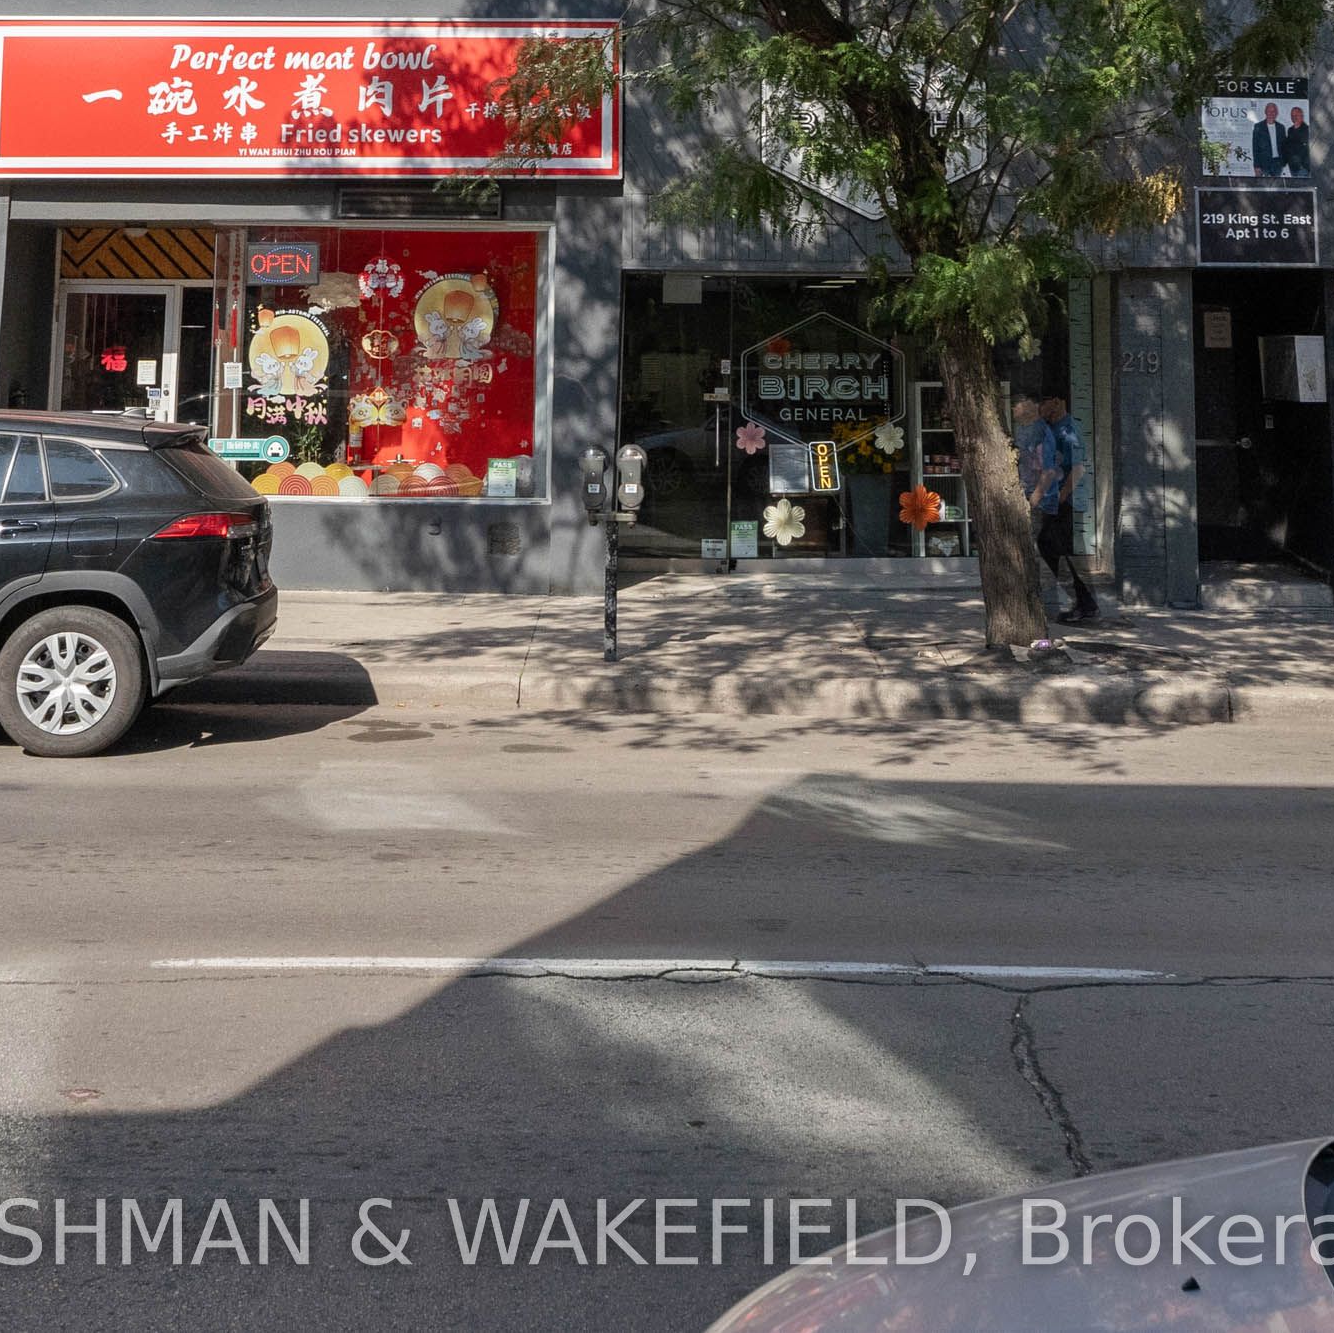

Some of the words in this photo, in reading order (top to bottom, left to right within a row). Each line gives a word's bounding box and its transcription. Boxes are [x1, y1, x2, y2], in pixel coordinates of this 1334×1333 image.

[169, 43, 276, 75] Perfect
[283, 45, 355, 70] meat
[362, 41, 437, 70] bowl
[81, 73, 453, 120] 一碗水煮肉片
[1254, 81, 1295, 94] SALE
[1210, 106, 1248, 119] OPUS
[161, 122, 259, 145] 手工炸串
[280, 123, 342, 144] Fried
[348, 123, 442, 144] skewers
[248, 147, 270, 156] WAN
[271, 147, 293, 156] SHUI
[294, 148, 311, 156] ZHU
[313, 147, 333, 156] ROU
[335, 147, 356, 156] PIAN
[1202, 214, 1224, 224] 219
[1228, 214, 1259, 226] King
[1262, 214, 1279, 224] St.
[1283, 214, 1312, 225] East
[1225, 228, 1250, 240] Apt
[1263, 228, 1277, 239] to
[1280, 228, 1290, 239] 6
[250, 254, 312, 274] OPEN
[101, 346, 128, 372] 福
[763, 352, 882, 370] CHERRY
[1122, 350, 1160, 374] 219
[758, 375, 888, 401] BIRCH
[779, 408, 868, 421] GENERAL
[817, 444, 832, 489] OPEN
